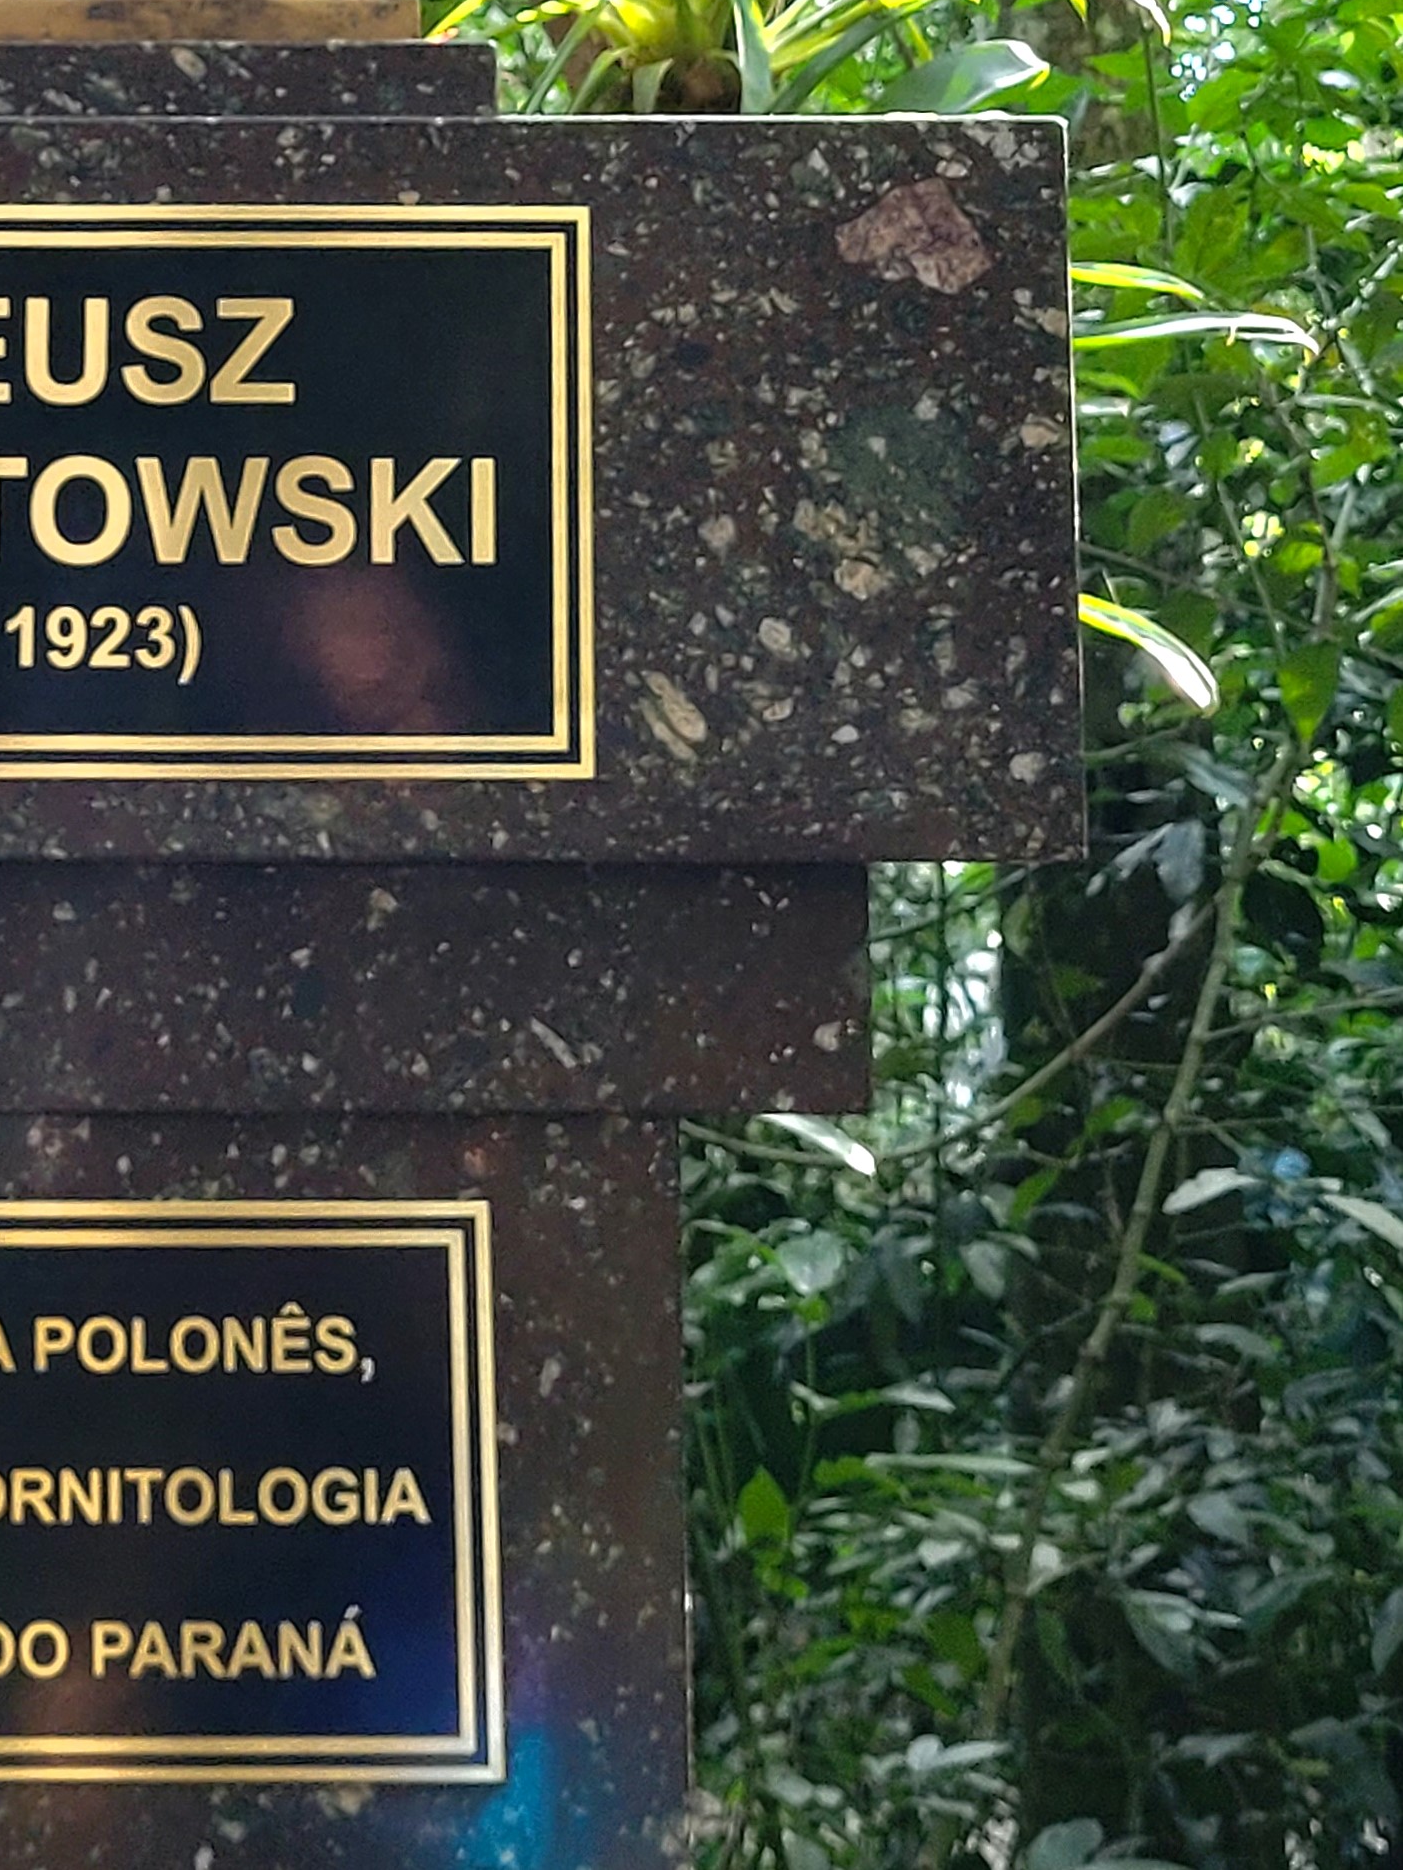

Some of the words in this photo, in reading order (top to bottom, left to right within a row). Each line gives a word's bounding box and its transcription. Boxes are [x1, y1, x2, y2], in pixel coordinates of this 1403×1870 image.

[4, 605, 203, 685] 1923)
[34, 1302, 376, 1383] POLONÊS,
[91, 1605, 377, 1679] PARANÁ
